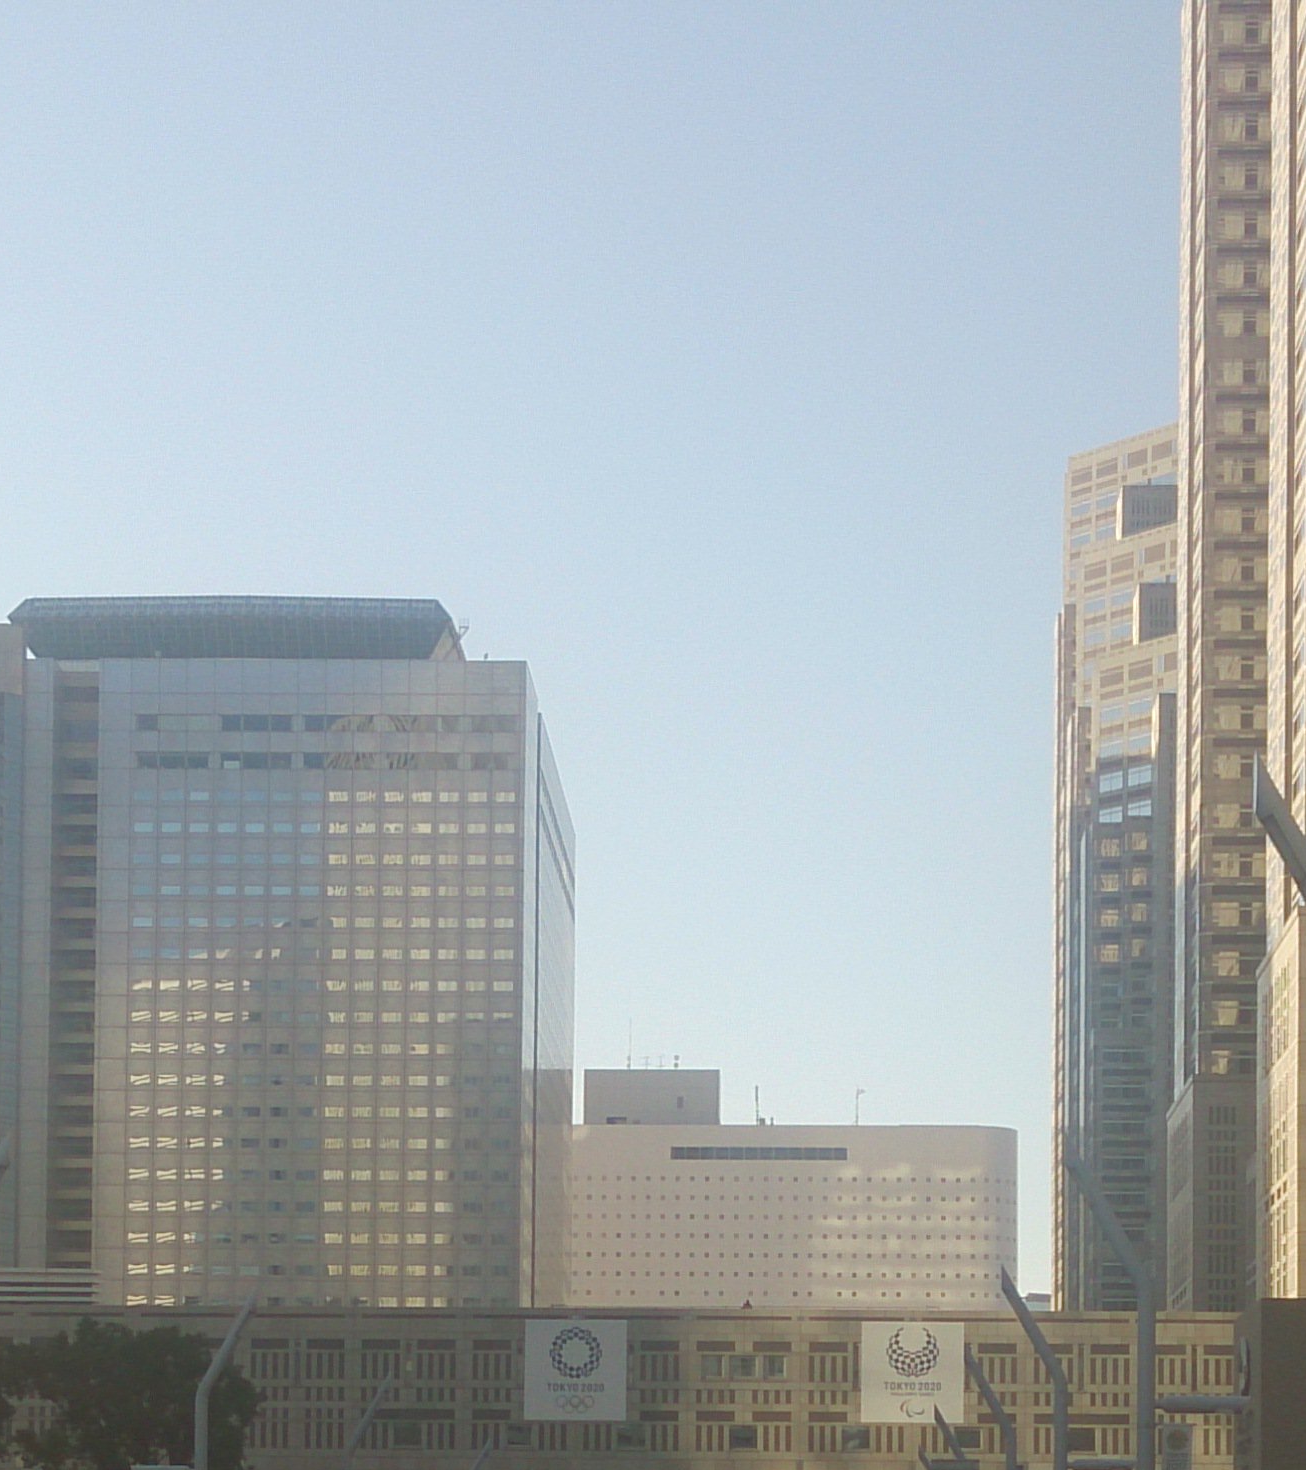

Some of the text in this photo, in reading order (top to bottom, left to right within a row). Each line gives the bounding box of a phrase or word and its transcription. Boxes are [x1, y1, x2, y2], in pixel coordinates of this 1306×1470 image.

[547, 1383, 605, 1392] TOKYO 2020
[884, 1381, 942, 1391] TOKYO 2020
